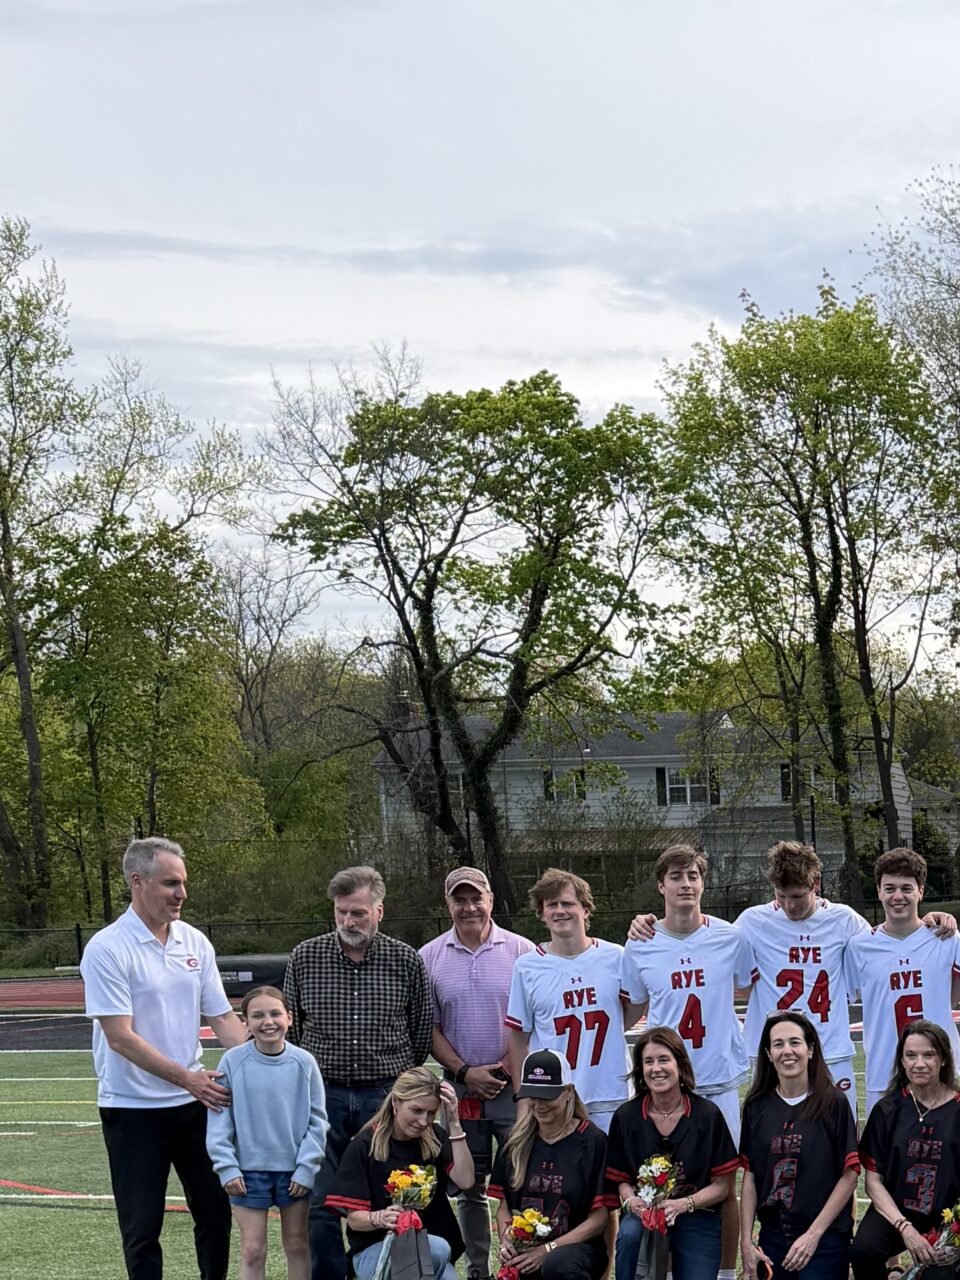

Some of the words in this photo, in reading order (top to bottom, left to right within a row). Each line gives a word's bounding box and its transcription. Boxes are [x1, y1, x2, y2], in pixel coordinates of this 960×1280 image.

[788, 946, 822, 964] RYE
[671, 968, 706, 990] RYE
[889, 970, 923, 991] RYE
[562, 986, 598, 1010] RYE
[776, 968, 831, 1023] 24
[678, 993, 706, 1050] 4
[554, 1009, 610, 1071] 77
[771, 1134, 802, 1154] RYE
[907, 1138, 943, 1160] RYE
[529, 1174, 563, 1194] RYE
[903, 1163, 937, 1215] 3
